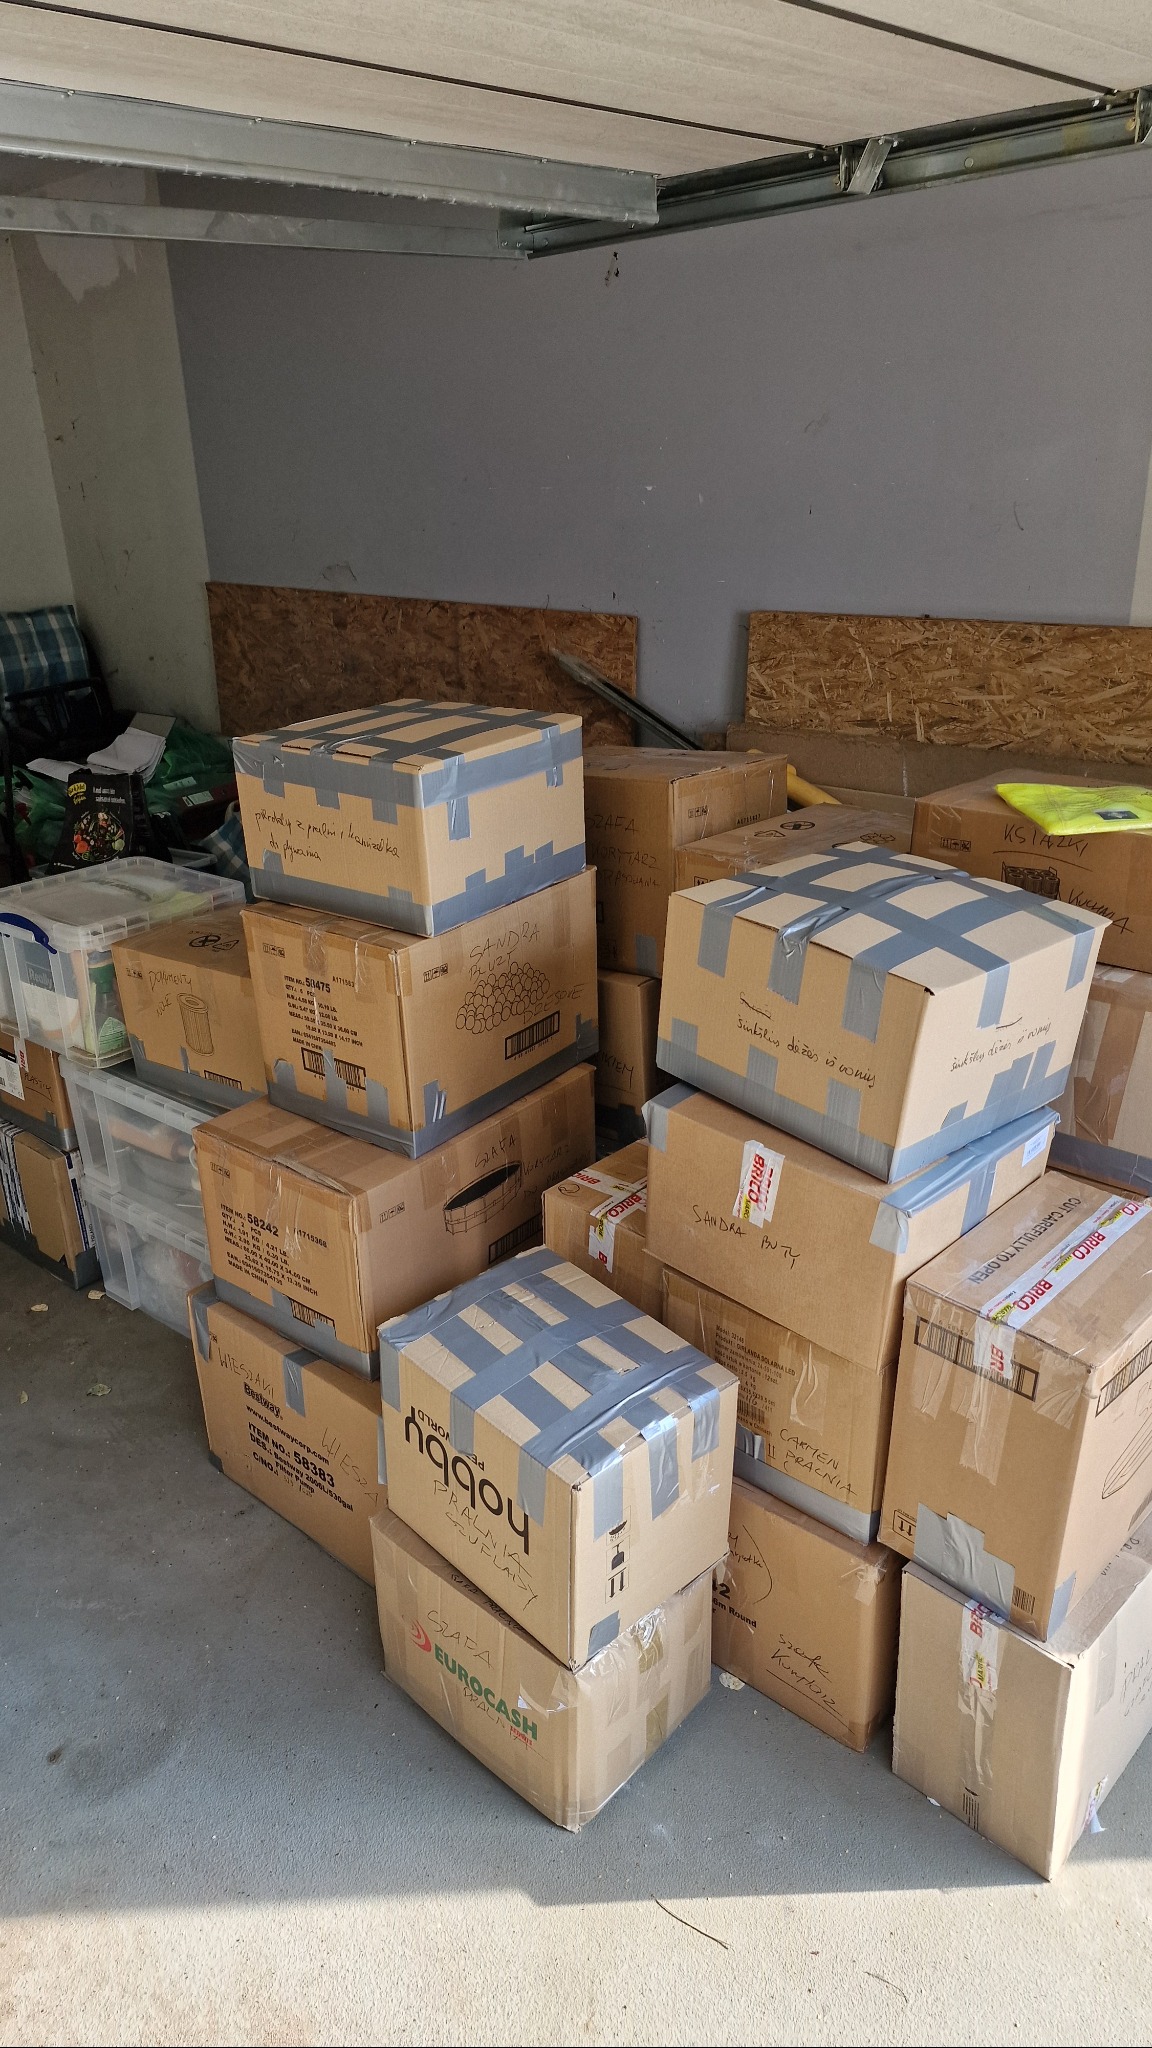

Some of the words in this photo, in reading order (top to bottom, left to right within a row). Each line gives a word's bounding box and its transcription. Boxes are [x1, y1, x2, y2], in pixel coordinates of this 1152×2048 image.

[296, 820, 305, 831] z
[470, 922, 541, 965] SANDRA
[747, 1153, 766, 1204] BRICO
[221, 1204, 234, 1215] ITEM
[247, 1212, 279, 1237] 58242
[607, 1194, 642, 1218] BRICO
[1058, 1197, 1082, 1214] CUT
[250, 1226, 262, 1237] PCS
[252, 1234, 260, 1243] KG
[266, 1242, 278, 1253] 4.21
[692, 1204, 747, 1237] SANDRA
[761, 1235, 801, 1270] BUTY
[1010, 1210, 1064, 1253] CAREFULLY
[1072, 1231, 1106, 1260] BRICO
[252, 1243, 261, 1252] KG
[996, 1250, 1015, 1263] TO
[228, 1260, 244, 1273] MADE
[244, 1269, 251, 1277] IN
[251, 1272, 269, 1286] CHINA
[302, 1276, 311, 1285] CM
[968, 1260, 1002, 1285] OPEN
[303, 1284, 319, 1297] INCH
[1016, 1279, 1054, 1311] BRICO
[760, 1353, 785, 1372] SOLARNA
[784, 1365, 796, 1377] LED
[244, 1382, 281, 1420] Bestway
[246, 1404, 330, 1466] www.bestwaycorp.com
[780, 1428, 839, 1470] CARMEN
[248, 1422, 270, 1444] ITEM
[293, 1450, 335, 1488] 58383
[274, 1452, 304, 1478] Bestway
[322, 1426, 379, 1507] WIESZA
[274, 1461, 294, 1478] Filter
[295, 1475, 315, 1494] Pump
[404, 1406, 529, 1556] hobby
[434, 1480, 532, 1578] PRALNIA
[728, 1606, 758, 1629] Round
[434, 1644, 538, 1741] EUROCASH
